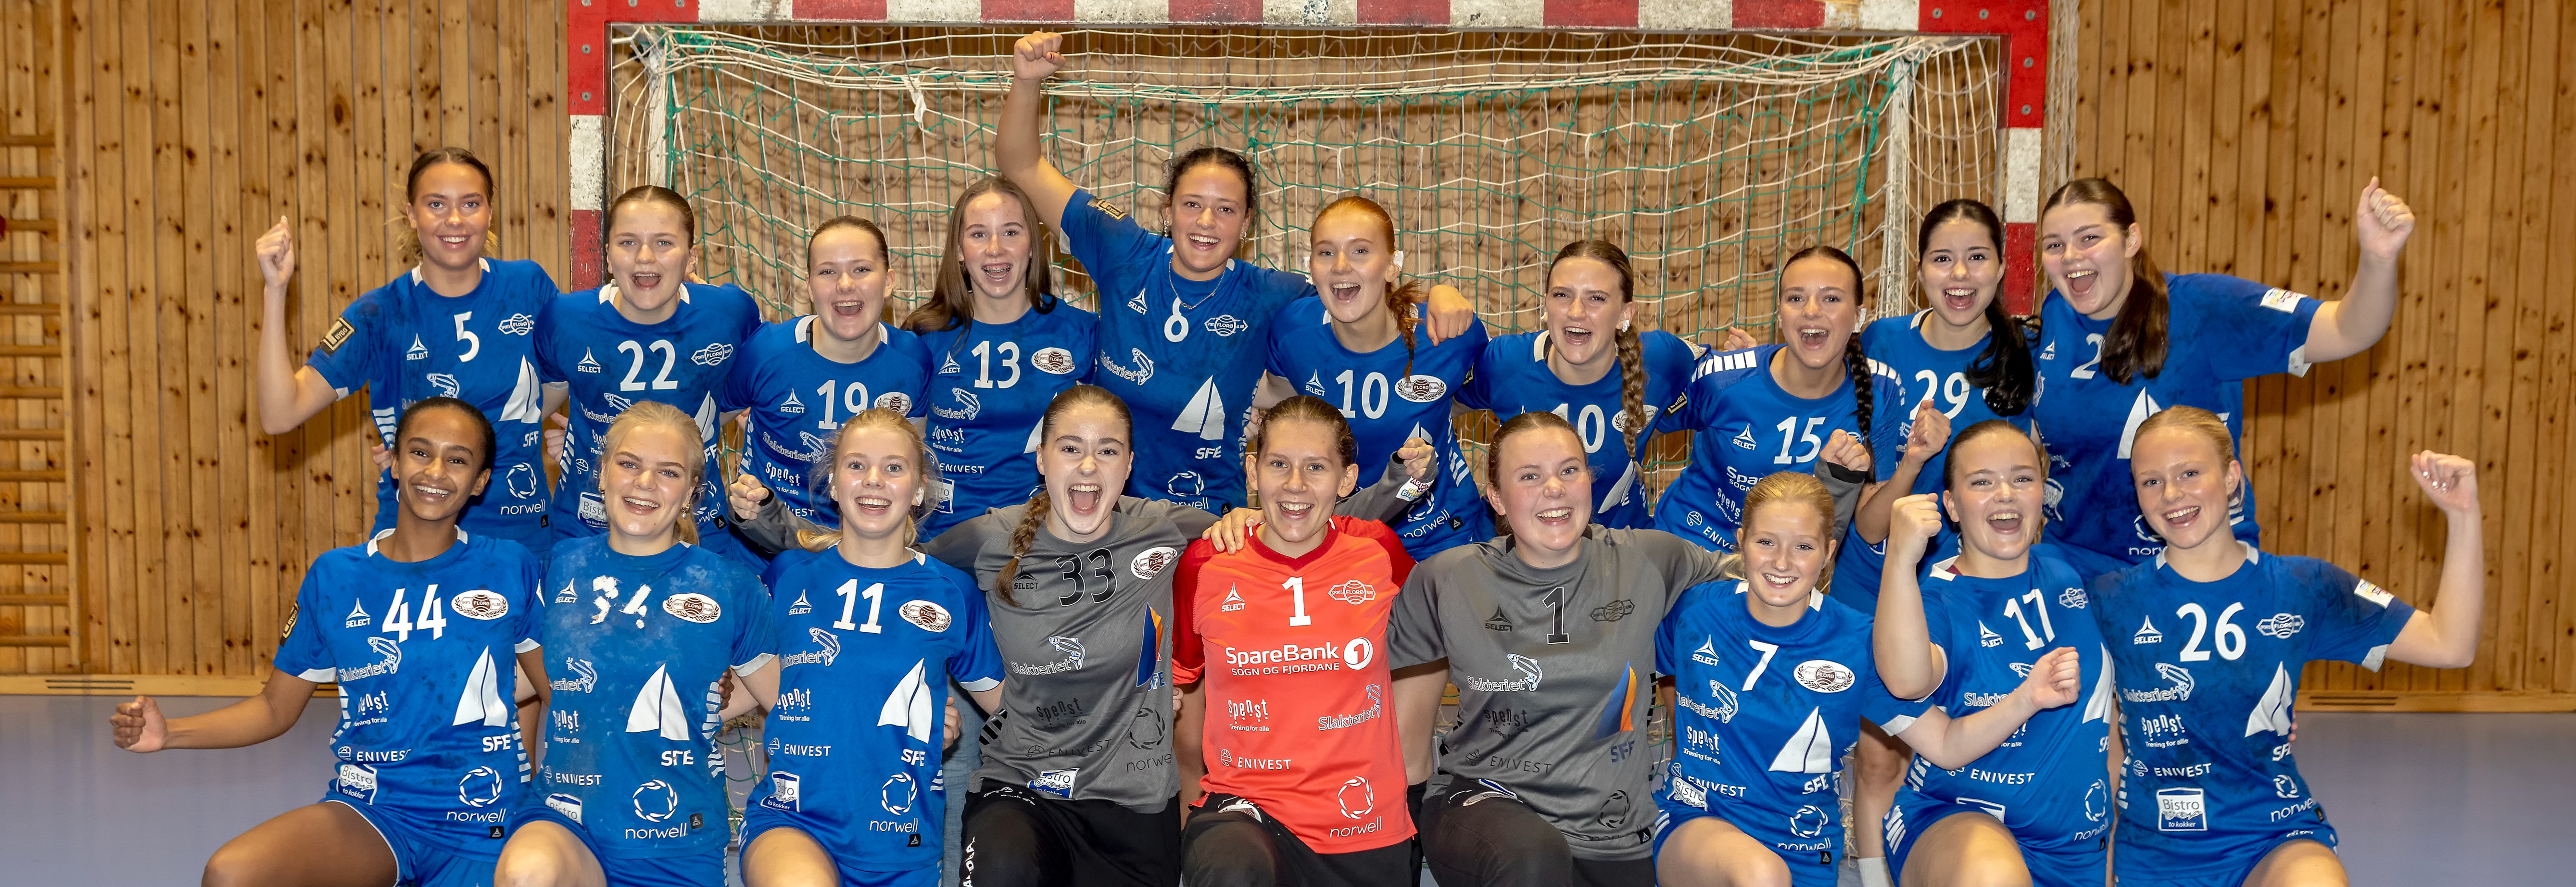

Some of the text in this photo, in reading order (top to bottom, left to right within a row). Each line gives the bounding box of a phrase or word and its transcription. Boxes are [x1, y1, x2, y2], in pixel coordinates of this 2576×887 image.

[1127, 300, 1147, 315] SELECT
[454, 311, 480, 362] 5
[406, 351, 428, 361] SELECT
[972, 340, 1021, 388] 13
[617, 339, 678, 391] 22
[1305, 385, 1325, 397] SELECT
[1336, 369, 1389, 419] 10
[1909, 369, 1970, 420] 29
[817, 380, 868, 429] 19
[762, 432, 812, 462] Slakteriet
[1733, 438, 1756, 450] SELECT
[1774, 416, 1826, 464] 15
[1195, 446, 1222, 459] SFE
[940, 463, 985, 474] ENIVEST
[501, 499, 545, 515] norwell
[1404, 509, 1450, 538] norwell
[1703, 526, 1736, 550] ENIVE
[1055, 548, 1117, 607] 33
[1013, 582, 1038, 590] SELECT
[833, 578, 884, 634] 11
[1222, 602, 1245, 612] SELECT
[1281, 576, 1312, 627] 1
[382, 584, 446, 643] 44
[788, 607, 812, 615] SELECT
[1542, 587, 1570, 644] 1
[346, 618, 371, 628] SELECT
[1485, 623, 1513, 632] SELECT
[2004, 588, 2055, 651] 17
[2176, 601, 2247, 662] 26
[2134, 635, 2162, 645] SELECT
[1225, 642, 1340, 668] SpareBank
[1692, 653, 1719, 666] SELECT
[1010, 658, 1072, 675] Slakteriet
[1231, 662, 1340, 676] SOGN OG FJORDANE
[1742, 639, 1779, 691] 7
[550, 678, 582, 691] eriet
[1148, 671, 1166, 691] FE
[1467, 676, 1526, 692] Slakteriet
[1676, 691, 1720, 720] lakeriet
[1964, 692, 2008, 707] Slakte
[1318, 706, 1375, 730] Slakteriet
[482, 734, 511, 752] SFE
[784, 744, 831, 757] ENIVEST
[1126, 748, 1173, 773] norwe
[1683, 748, 1704, 760] Trening
[1237, 757, 1291, 770] ENIVEST
[1490, 756, 1552, 774] ENIVEST
[2153, 762, 2212, 778] ENIVEST
[342, 766, 372, 784] Bistro
[556, 773, 602, 786] ENIVEST
[1046, 773, 1071, 783] stro
[1970, 768, 2035, 785] ENIVEST
[348, 788, 366, 799] kokker
[773, 801, 790, 810] kokker
[2163, 798, 2200, 811] Bistro
[2271, 798, 2316, 823] norwe
[446, 808, 506, 823] norwell
[625, 823, 687, 839] norwell
[870, 818, 918, 833] norwell
[1330, 815, 1382, 838] norwell
